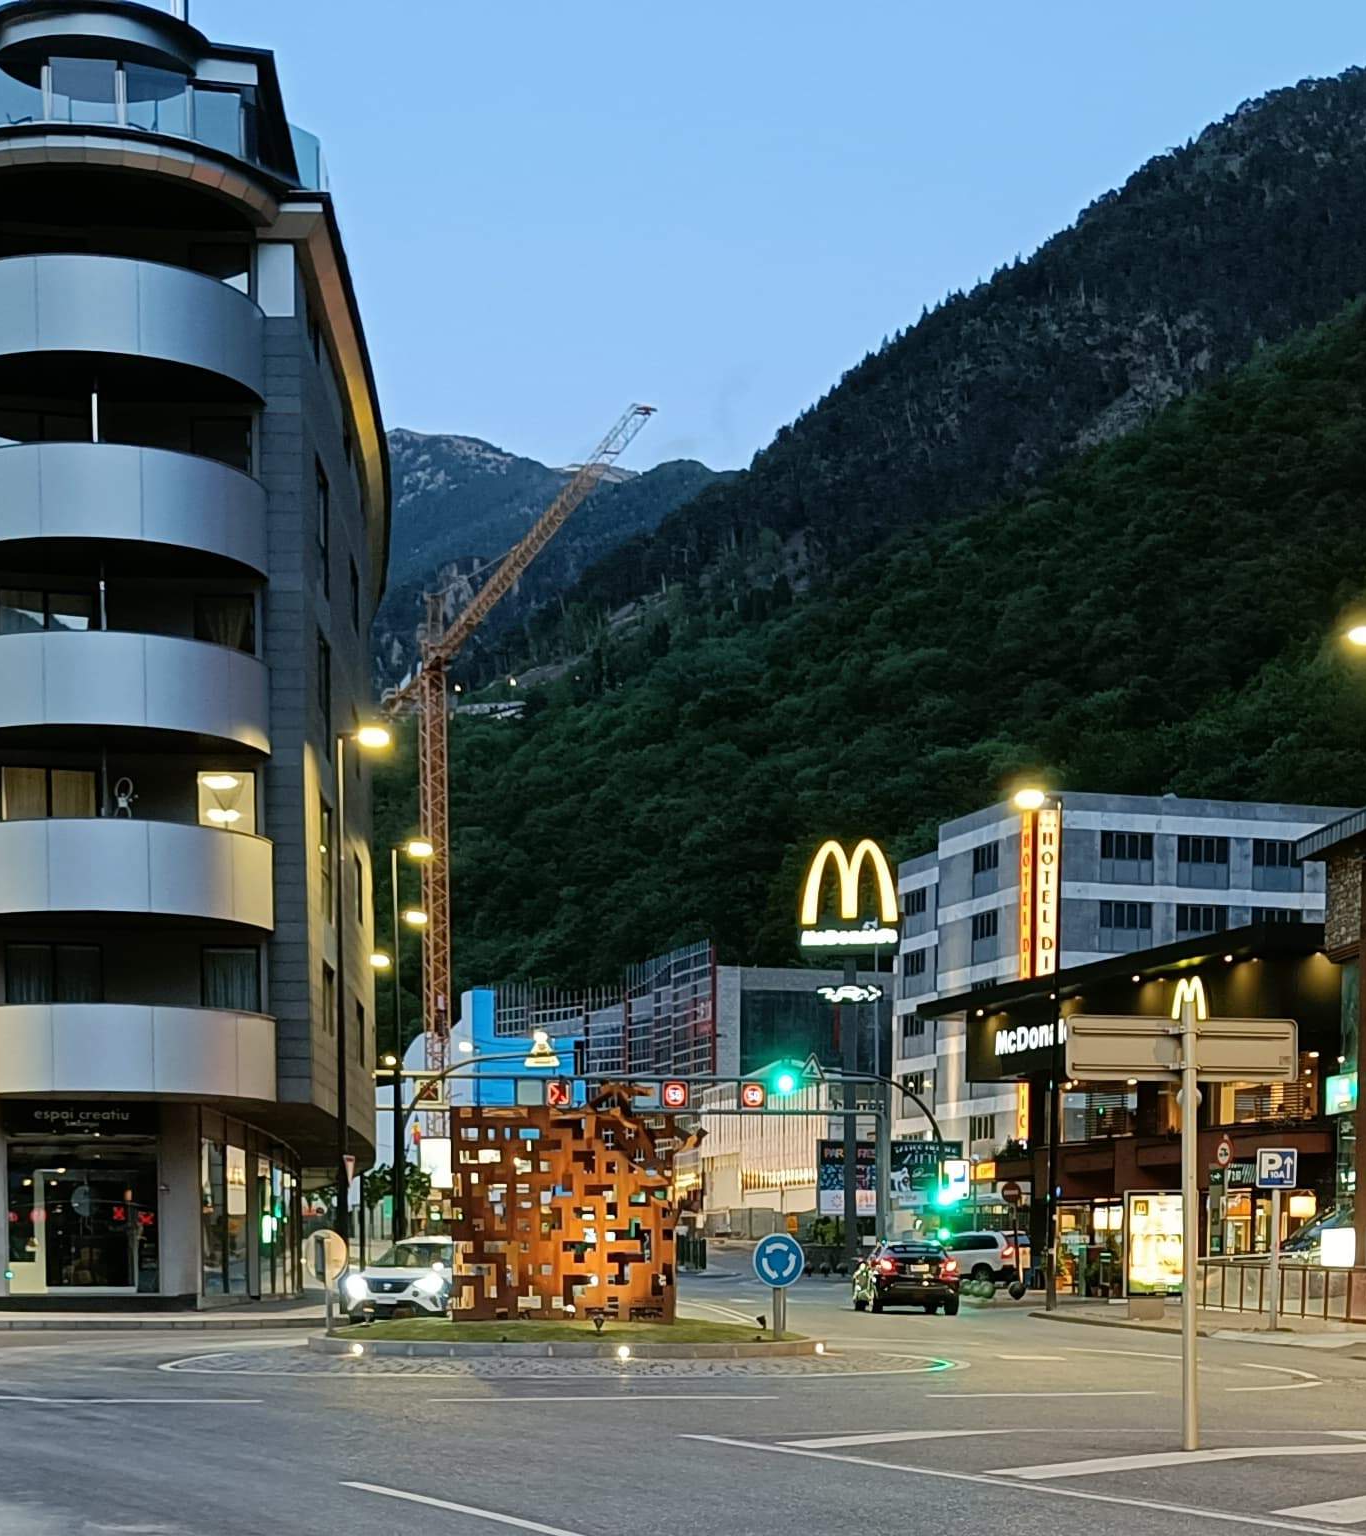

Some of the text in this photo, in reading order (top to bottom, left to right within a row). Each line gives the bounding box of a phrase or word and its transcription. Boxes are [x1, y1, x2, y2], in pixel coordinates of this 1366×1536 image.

[1042, 832, 1054, 924] HOTEL
[34, 1107, 130, 1122] espai creatiu
[1261, 1152, 1283, 1179] P
[1270, 1171, 1285, 1179] 10A
